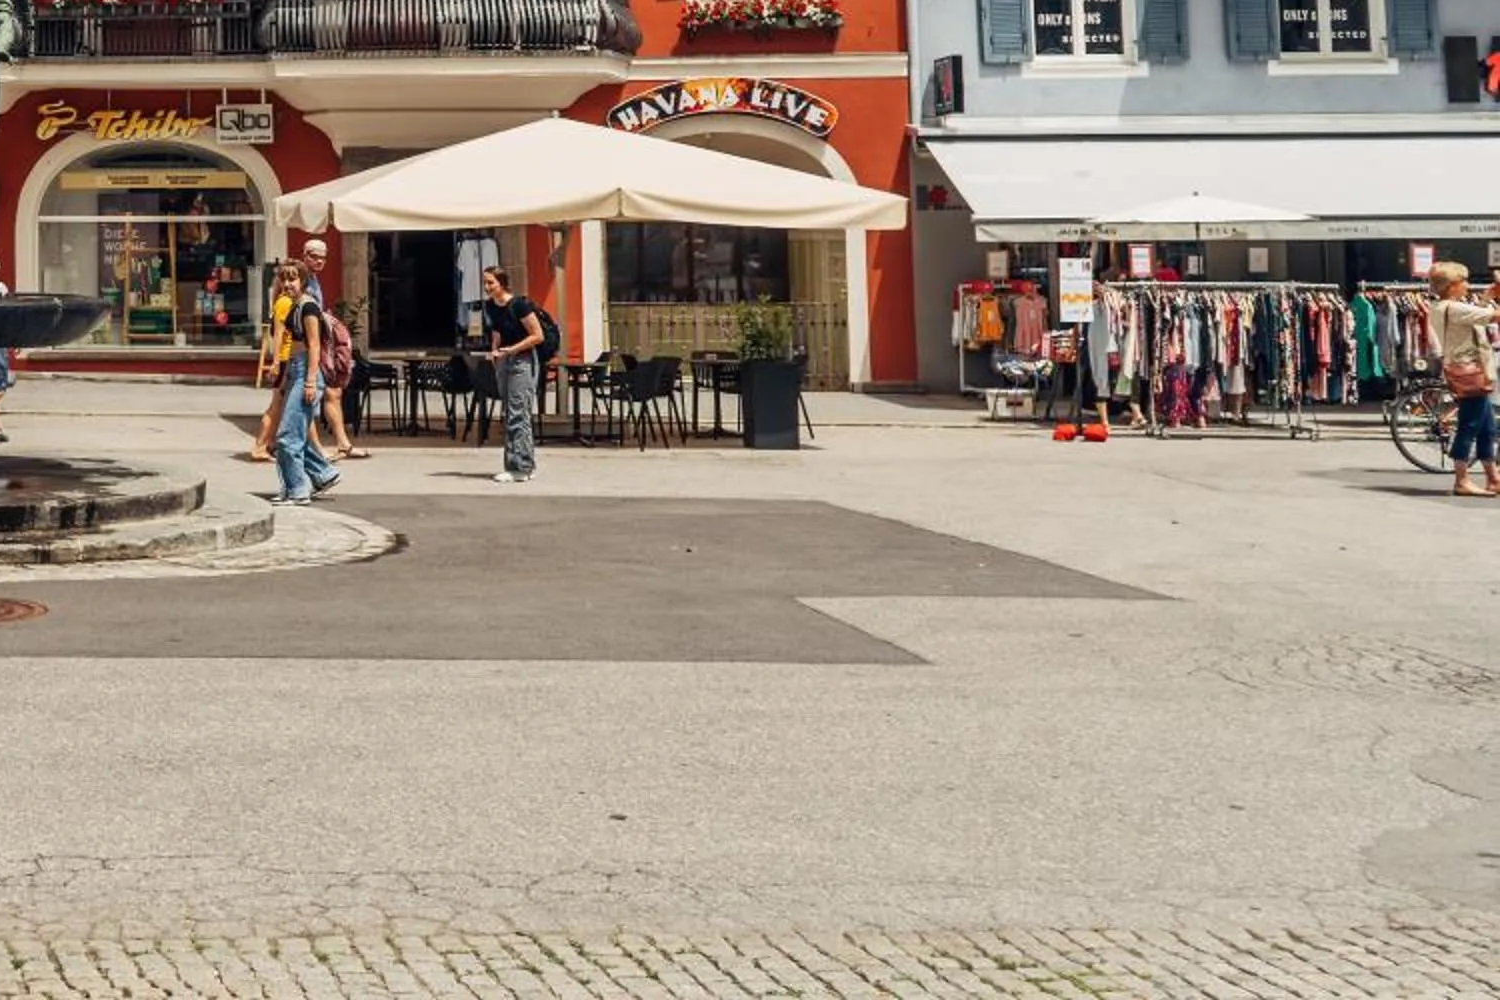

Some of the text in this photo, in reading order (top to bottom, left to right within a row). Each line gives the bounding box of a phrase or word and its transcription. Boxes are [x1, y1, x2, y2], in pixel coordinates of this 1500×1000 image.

[220, 109, 271, 132] Qbo
[617, 84, 830, 130] HAVANA LIVE
[87, 108, 213, 142] Tchibo
